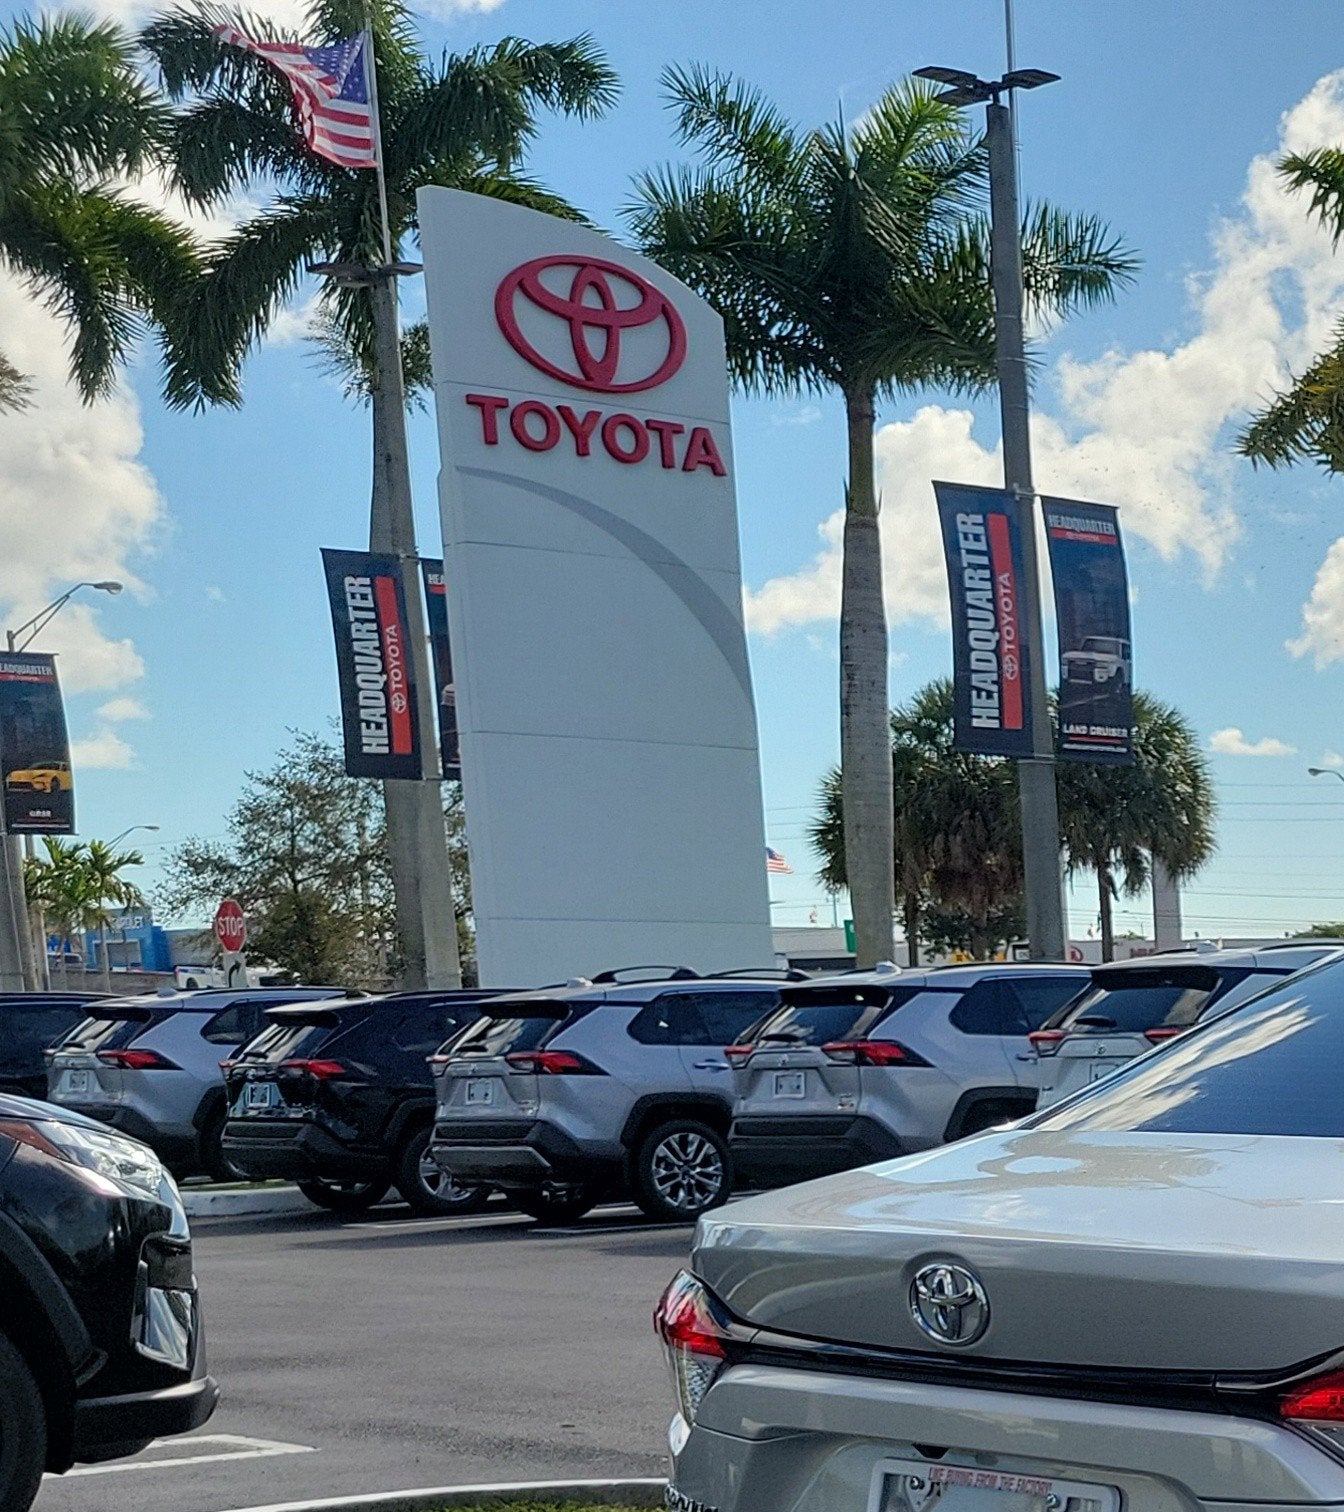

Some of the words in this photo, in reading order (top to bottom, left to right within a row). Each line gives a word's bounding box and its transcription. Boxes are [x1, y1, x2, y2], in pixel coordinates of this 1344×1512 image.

[465, 393, 727, 477] TOYOTA
[956, 512, 1000, 730] HEADQUARTER
[999, 572, 1017, 650] TOYOTA
[344, 574, 390, 755] HEADQUARTER
[385, 624, 403, 689] TOYOTA
[217, 916, 244, 937] STOP
